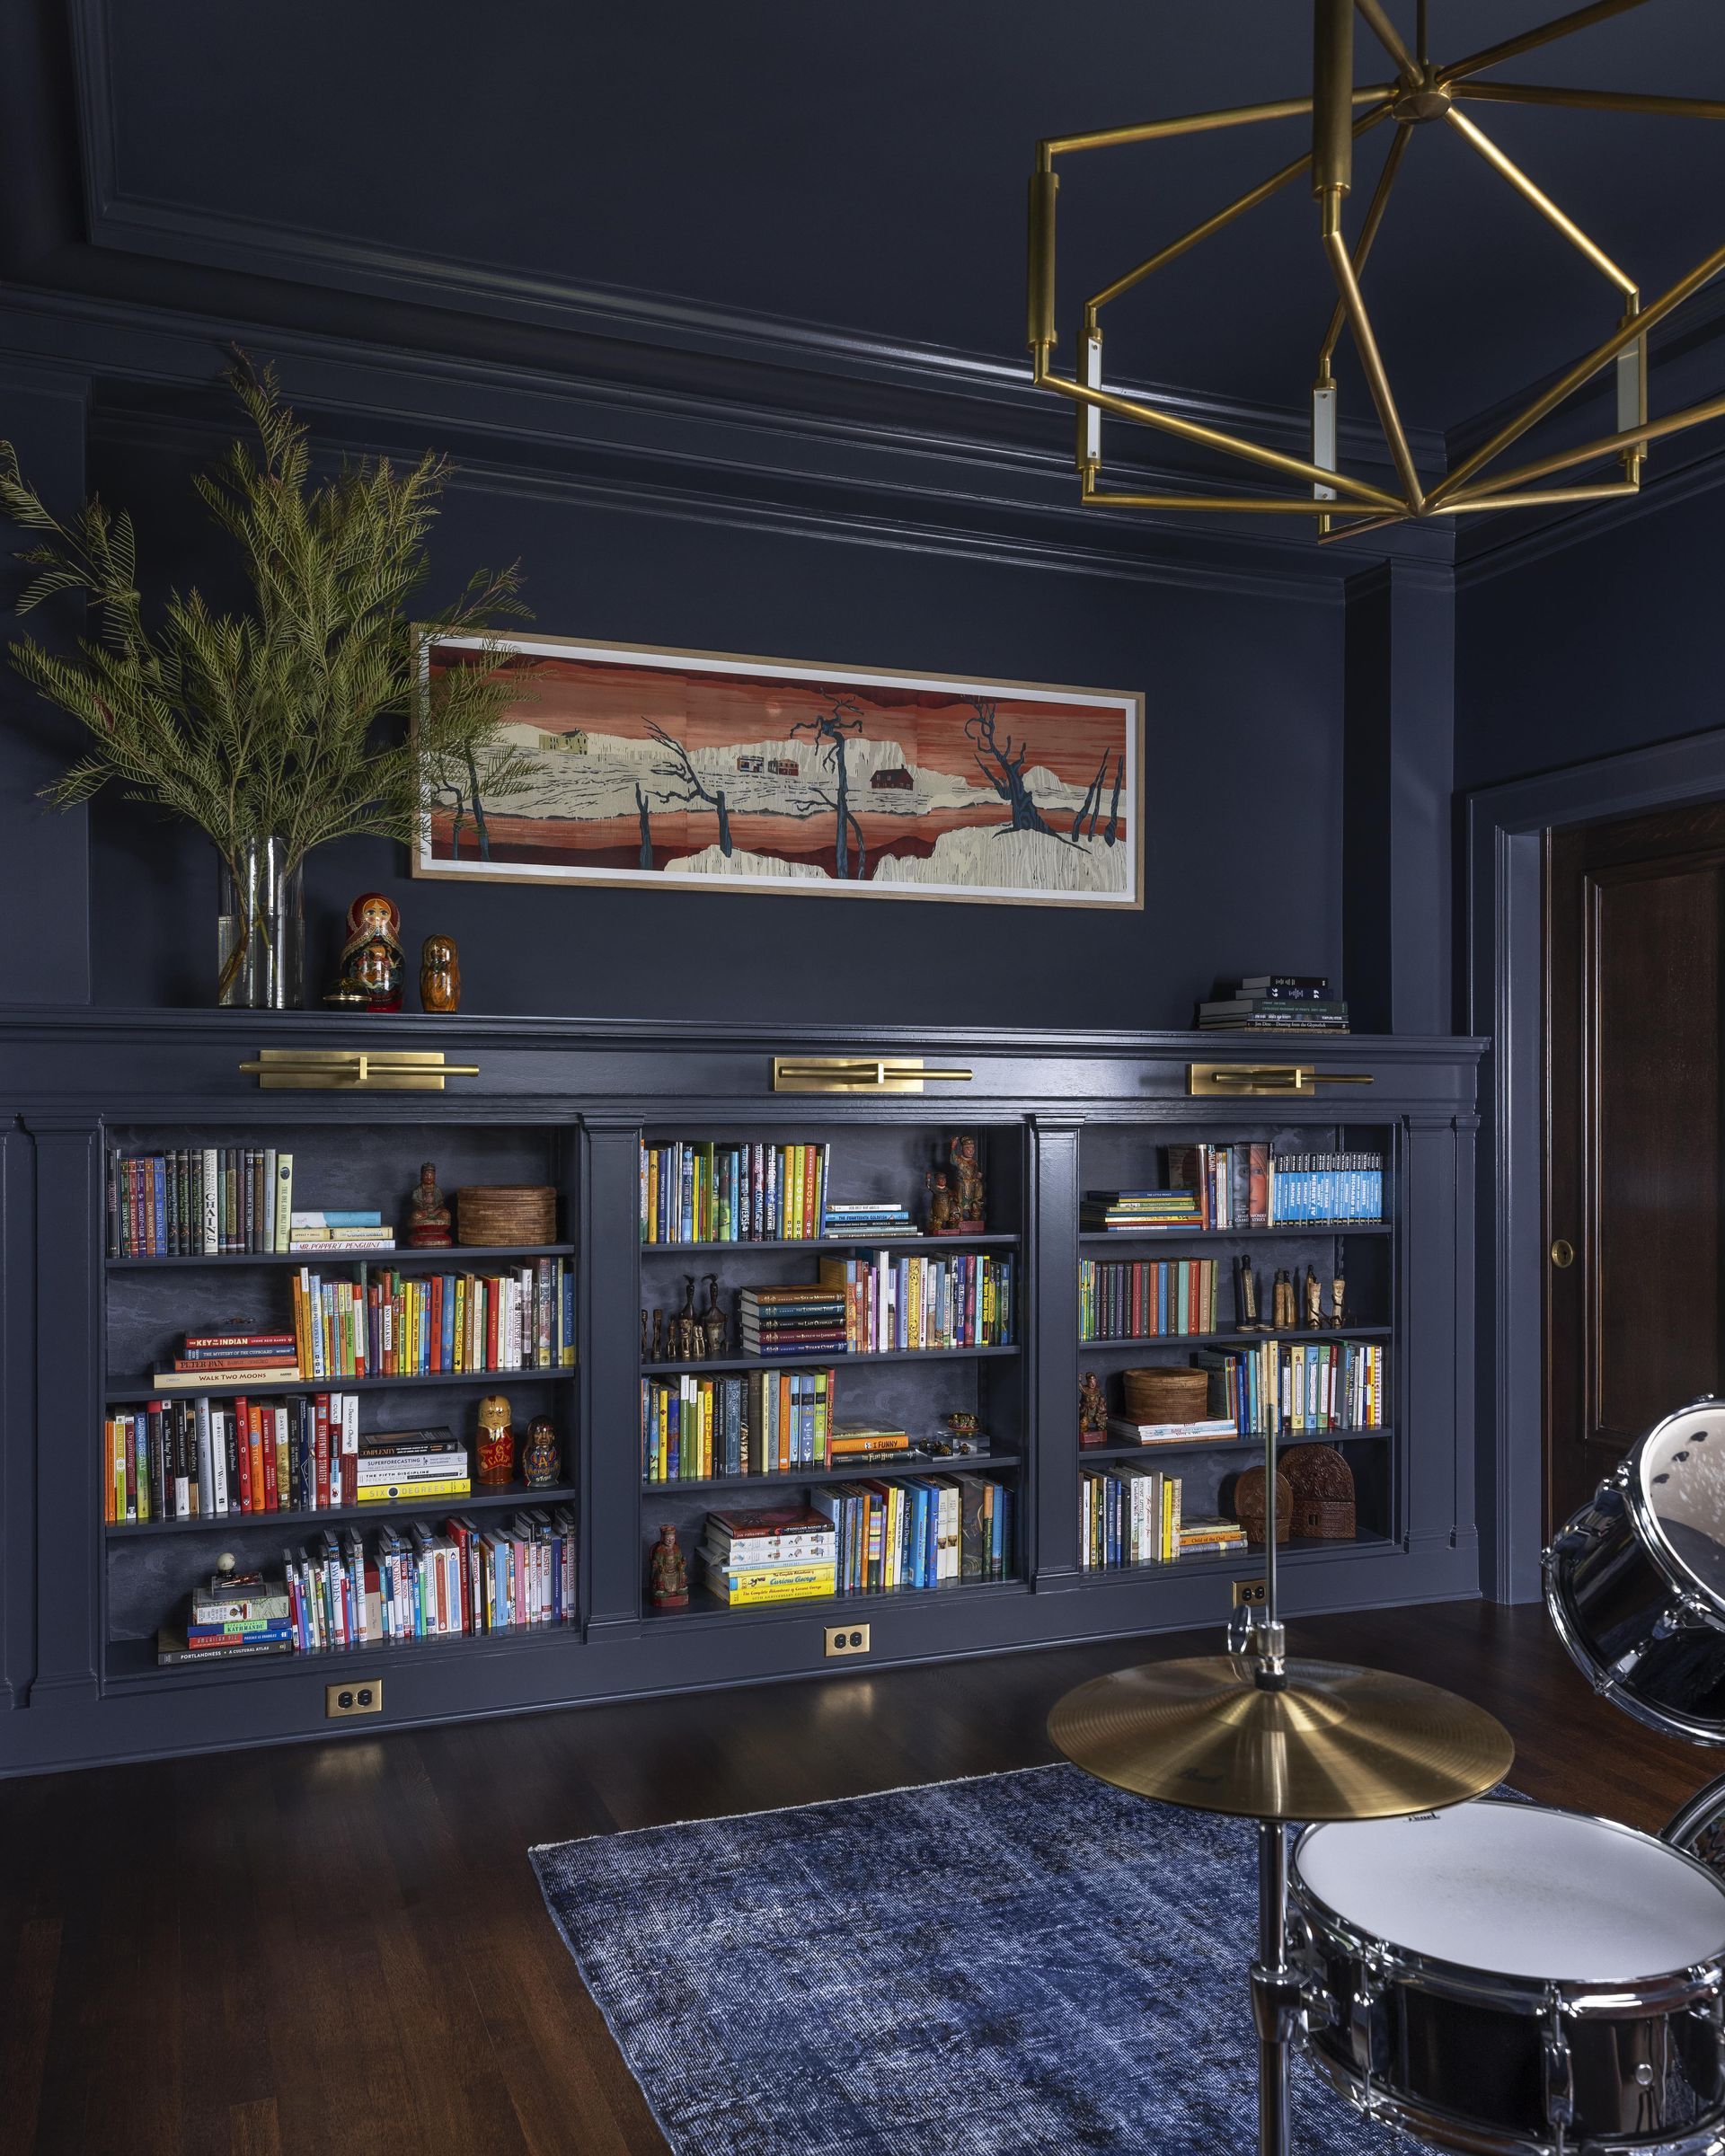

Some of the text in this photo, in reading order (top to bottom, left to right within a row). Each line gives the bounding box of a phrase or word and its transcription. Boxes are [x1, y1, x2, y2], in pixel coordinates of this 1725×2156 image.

[1311, 1207, 1316, 1215] IV
[206, 1193, 216, 1243] CHAINS
[385, 1308, 390, 1318] NO
[137, 1418, 146, 1441] DARING
[367, 1458, 420, 1466] SUPERFORECASTING
[402, 1484, 446, 1495] DEGREES
[393, 1560, 401, 1596] NORWAY
[332, 1565, 341, 1603] SWEDEN
[181, 1651, 221, 1659] PORTLANDNESS
